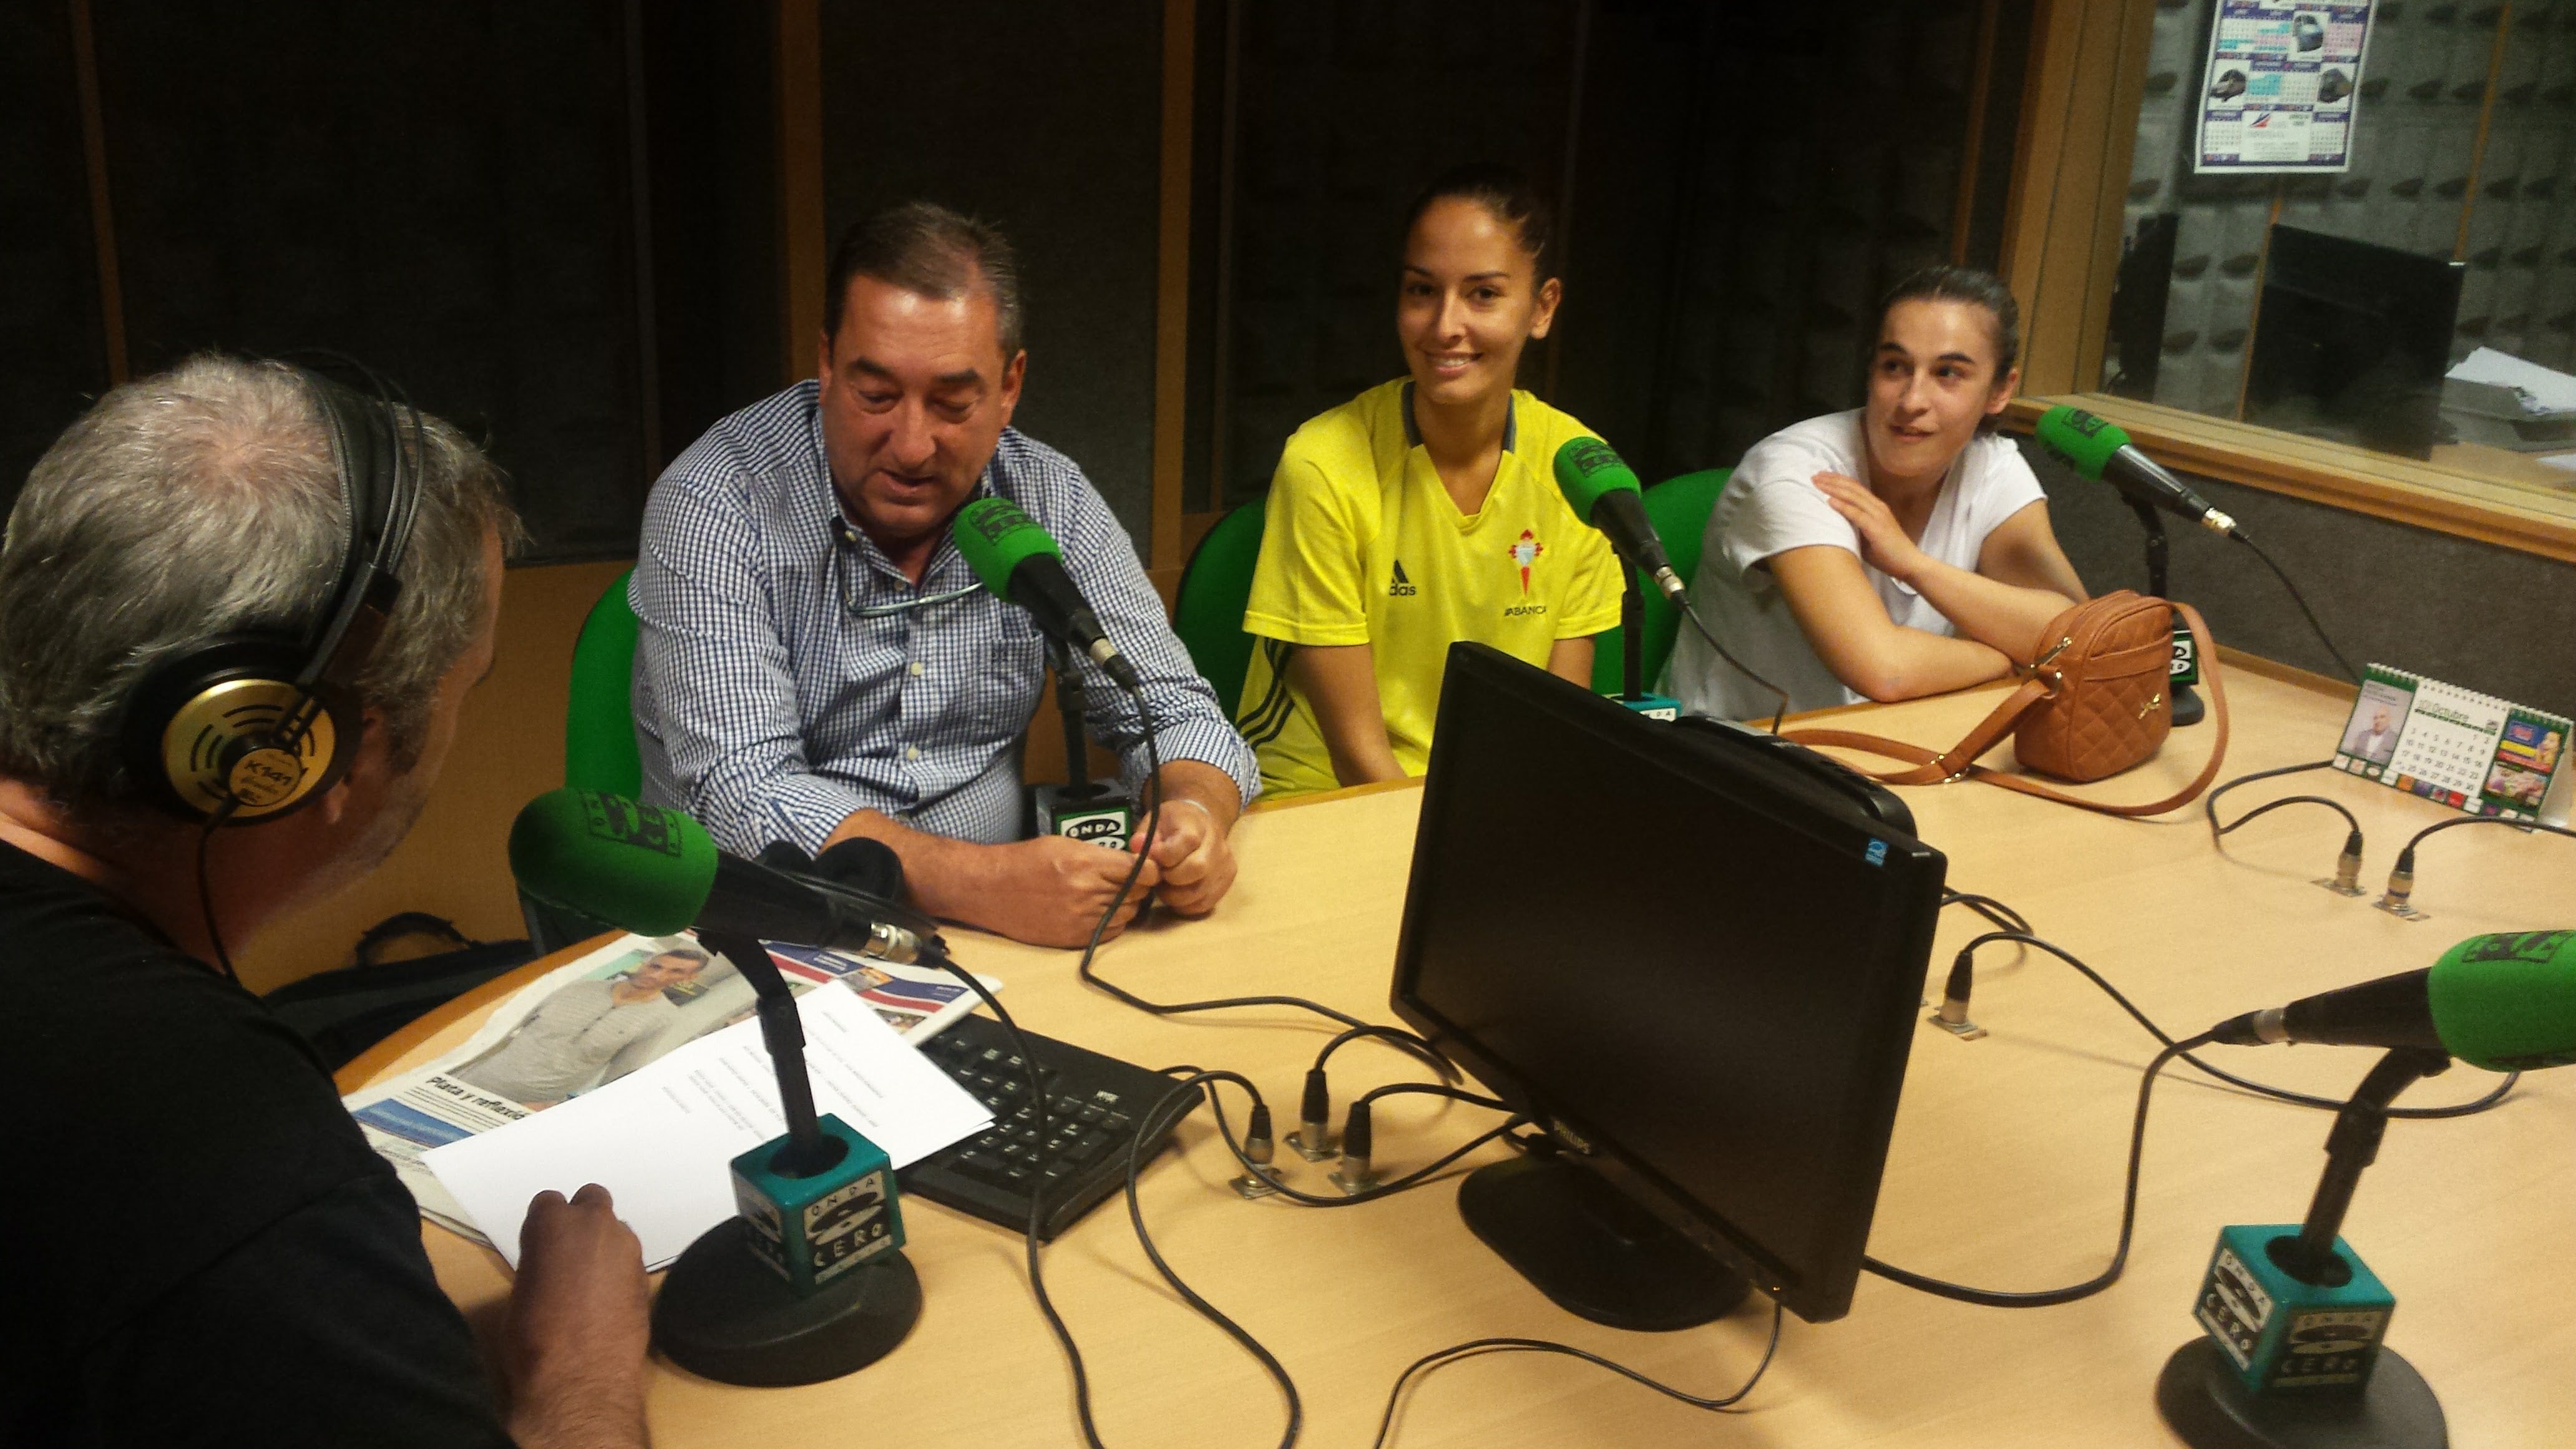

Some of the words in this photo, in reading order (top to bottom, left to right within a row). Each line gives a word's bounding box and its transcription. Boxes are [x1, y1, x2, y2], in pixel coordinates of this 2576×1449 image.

[1389, 583, 1417, 596] das
[1069, 822, 1117, 837] ONDA
[426, 1076, 464, 1095] Plata
[472, 1098, 531, 1121] reflexió
[811, 1177, 874, 1216] ONDA
[813, 1223, 883, 1267] CERO
